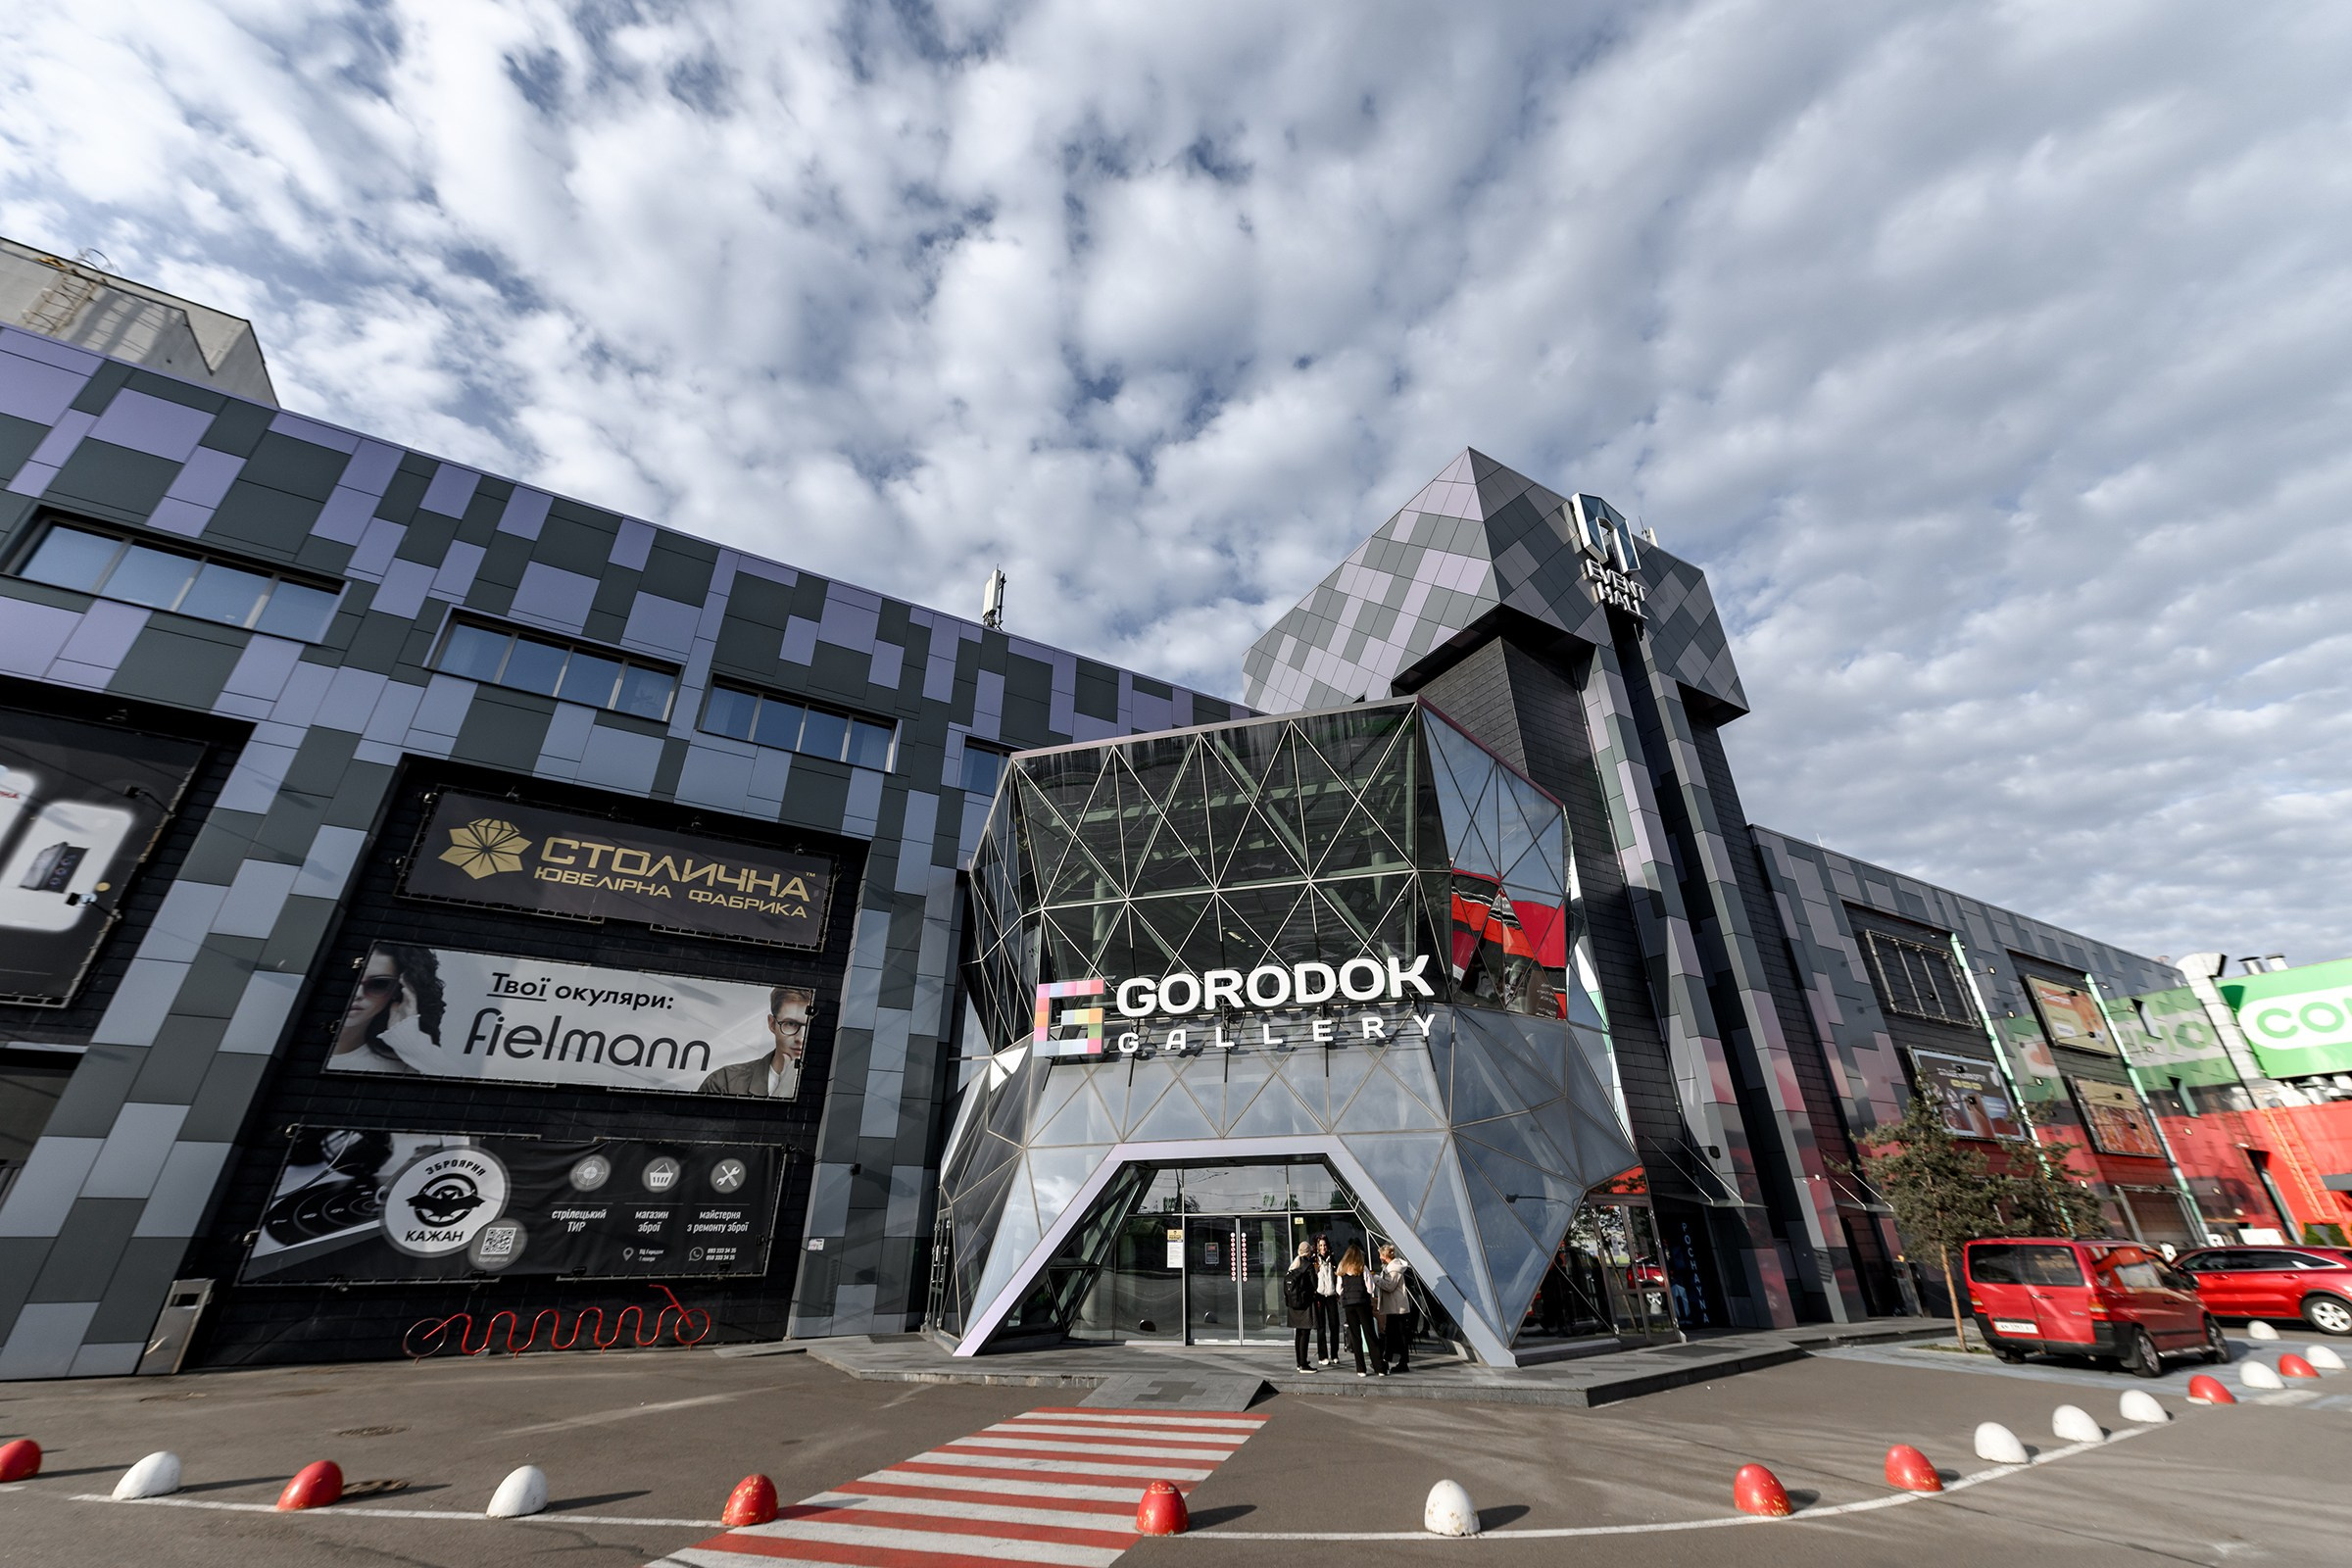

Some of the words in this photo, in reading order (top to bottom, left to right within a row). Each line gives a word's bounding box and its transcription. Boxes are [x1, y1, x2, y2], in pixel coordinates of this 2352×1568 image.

[1586, 559, 1646, 601] EVENT
[1596, 581, 1648, 619] HALL
[541, 836, 811, 903] СТОЛИЧНА
[534, 866, 672, 899] ЮВЕЛІРНА
[688, 889, 808, 918] ФАБРИКА
[490, 971, 552, 1001] Твої
[555, 983, 674, 1010] окуляри:
[1116, 954, 1436, 1018] GORODOK
[1117, 1013, 1437, 1054] GALLERY
[2256, 998, 2352, 1039] CO
[463, 1007, 711, 1071] fielmann
[424, 1159, 486, 1177] ЗБРОЯРНЯ
[551, 1208, 608, 1220] стрілецький
[567, 1221, 586, 1233] ТИР
[635, 1209, 669, 1220] магазин
[637, 1221, 662, 1234] зброї
[693, 1223, 726, 1233] ремонту
[727, 1220, 750, 1233] зброї
[699, 1209, 742, 1220] майстерня
[404, 1230, 465, 1243] КАЖАН
[1682, 1222, 1710, 1324] POCHAYNA
